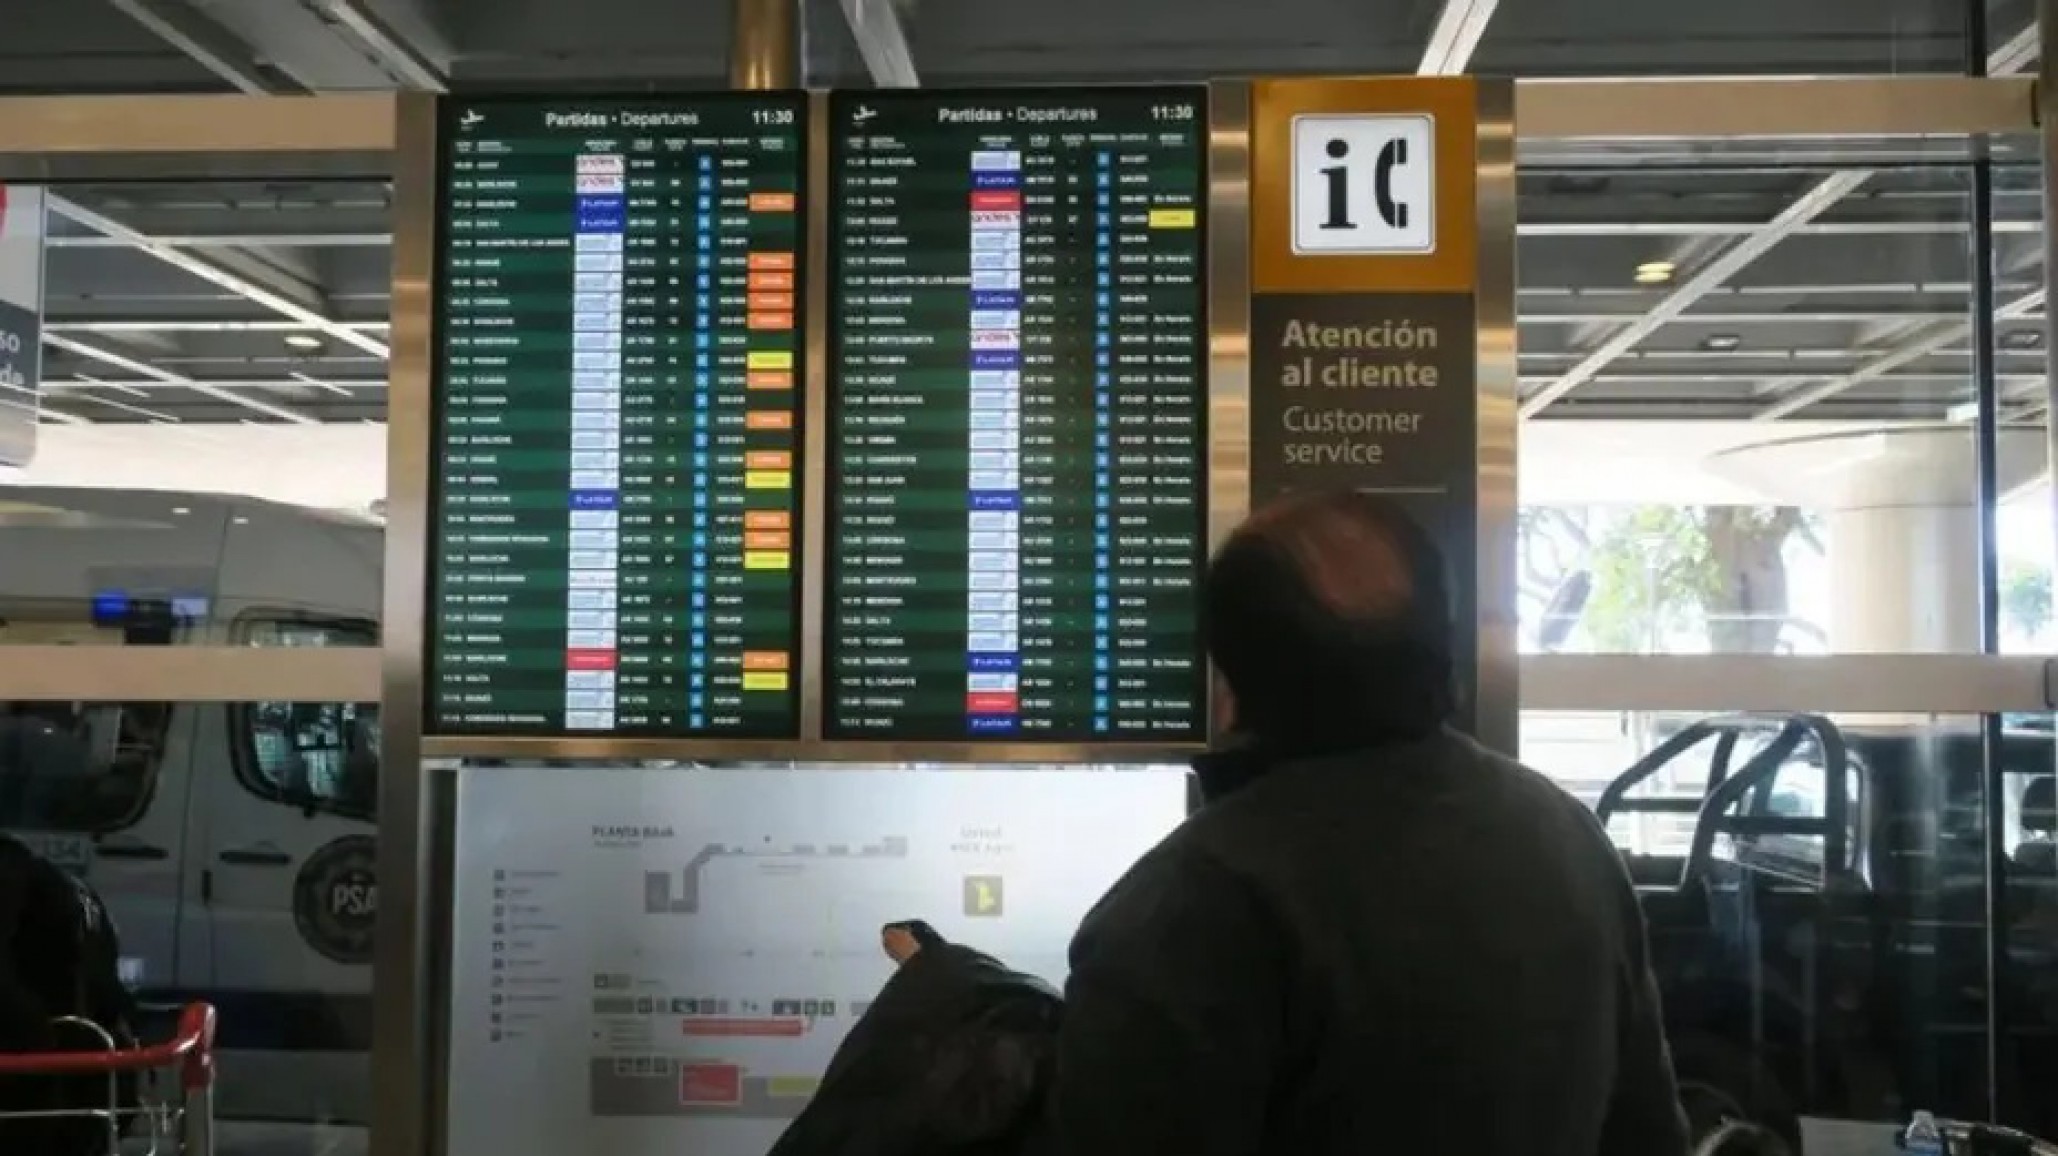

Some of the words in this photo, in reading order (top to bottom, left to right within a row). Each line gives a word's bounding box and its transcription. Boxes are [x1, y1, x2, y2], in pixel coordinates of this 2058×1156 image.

[545, 111, 607, 126] Partidas
[620, 111, 699, 129] Departures
[752, 109, 794, 125] 11:30
[938, 107, 1002, 122] Partidas
[1017, 107, 1098, 125] Departures
[1151, 104, 1194, 121] 11:30
[1281, 318, 1438, 349] Atención
[1281, 357, 1312, 387] al
[1321, 357, 1438, 388] cliente
[1283, 405, 1422, 433] Customer
[1283, 438, 1383, 464] service
